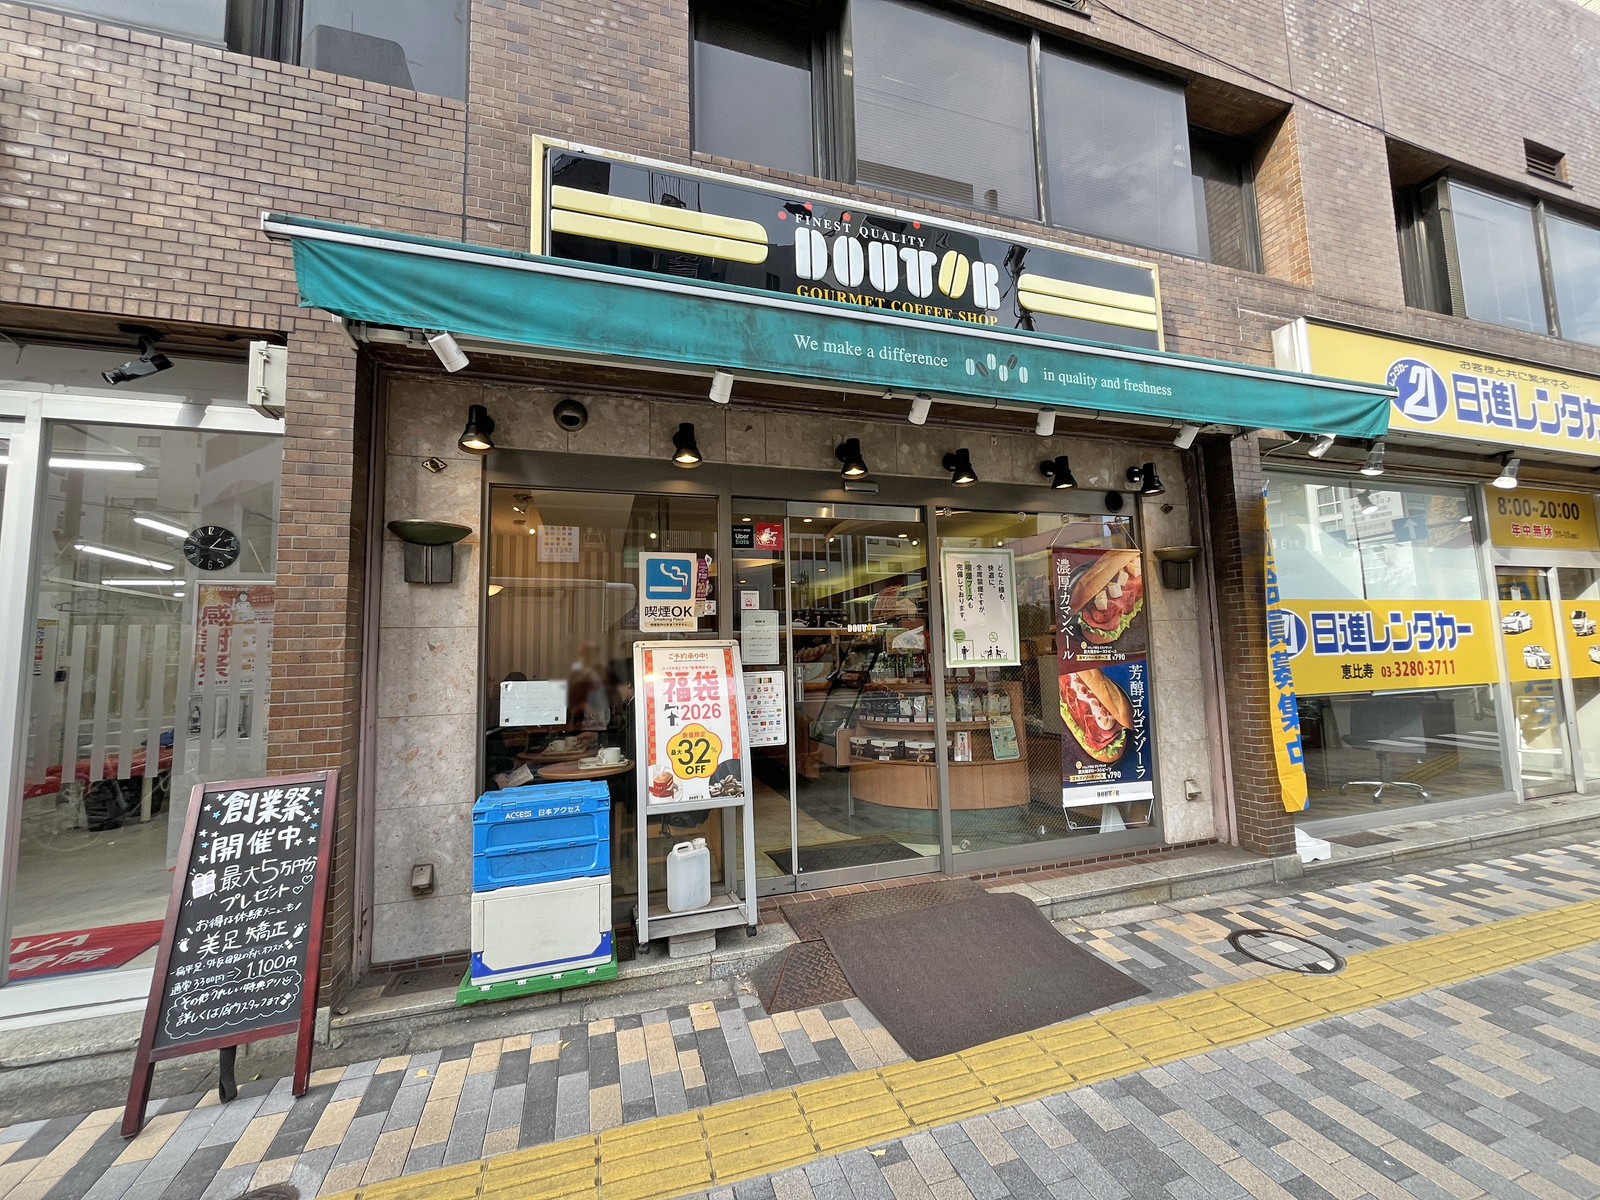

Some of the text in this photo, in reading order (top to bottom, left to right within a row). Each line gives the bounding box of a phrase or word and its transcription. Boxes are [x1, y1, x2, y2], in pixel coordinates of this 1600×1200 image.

[795, 213, 926, 248] FINEST QUALITY
[795, 226, 1000, 311] DOUTOR
[796, 284, 998, 326] GOURMET COFFEE SHOP
[793, 333, 948, 367] We make a difference
[1043, 367, 1173, 396] in quality and freshness
[1511, 523, 1553, 538] 年中無休
[644, 605, 693, 618] 喫煙OK
[1056, 558, 1075, 661] 濃厚カマンベール
[847, 623, 876, 632] DOUTOR
[1310, 611, 1473, 655] 日進レンタカー
[662, 669, 721, 703] 福袋
[1340, 663, 1374, 680] 恵比寿
[680, 703, 722, 721] 2026
[1128, 664, 1147, 780] 芳醇ゴルゴンゾーラ
[677, 738, 711, 765] 32
[685, 764, 706, 775] OFF
[220, 787, 312, 826] 創業祭
[504, 805, 581, 820] ACCESS 日本アクセス
[210, 825, 301, 864] 開催中
[219, 855, 318, 893] 最大5万円分
[219, 883, 290, 912] プレゼント
